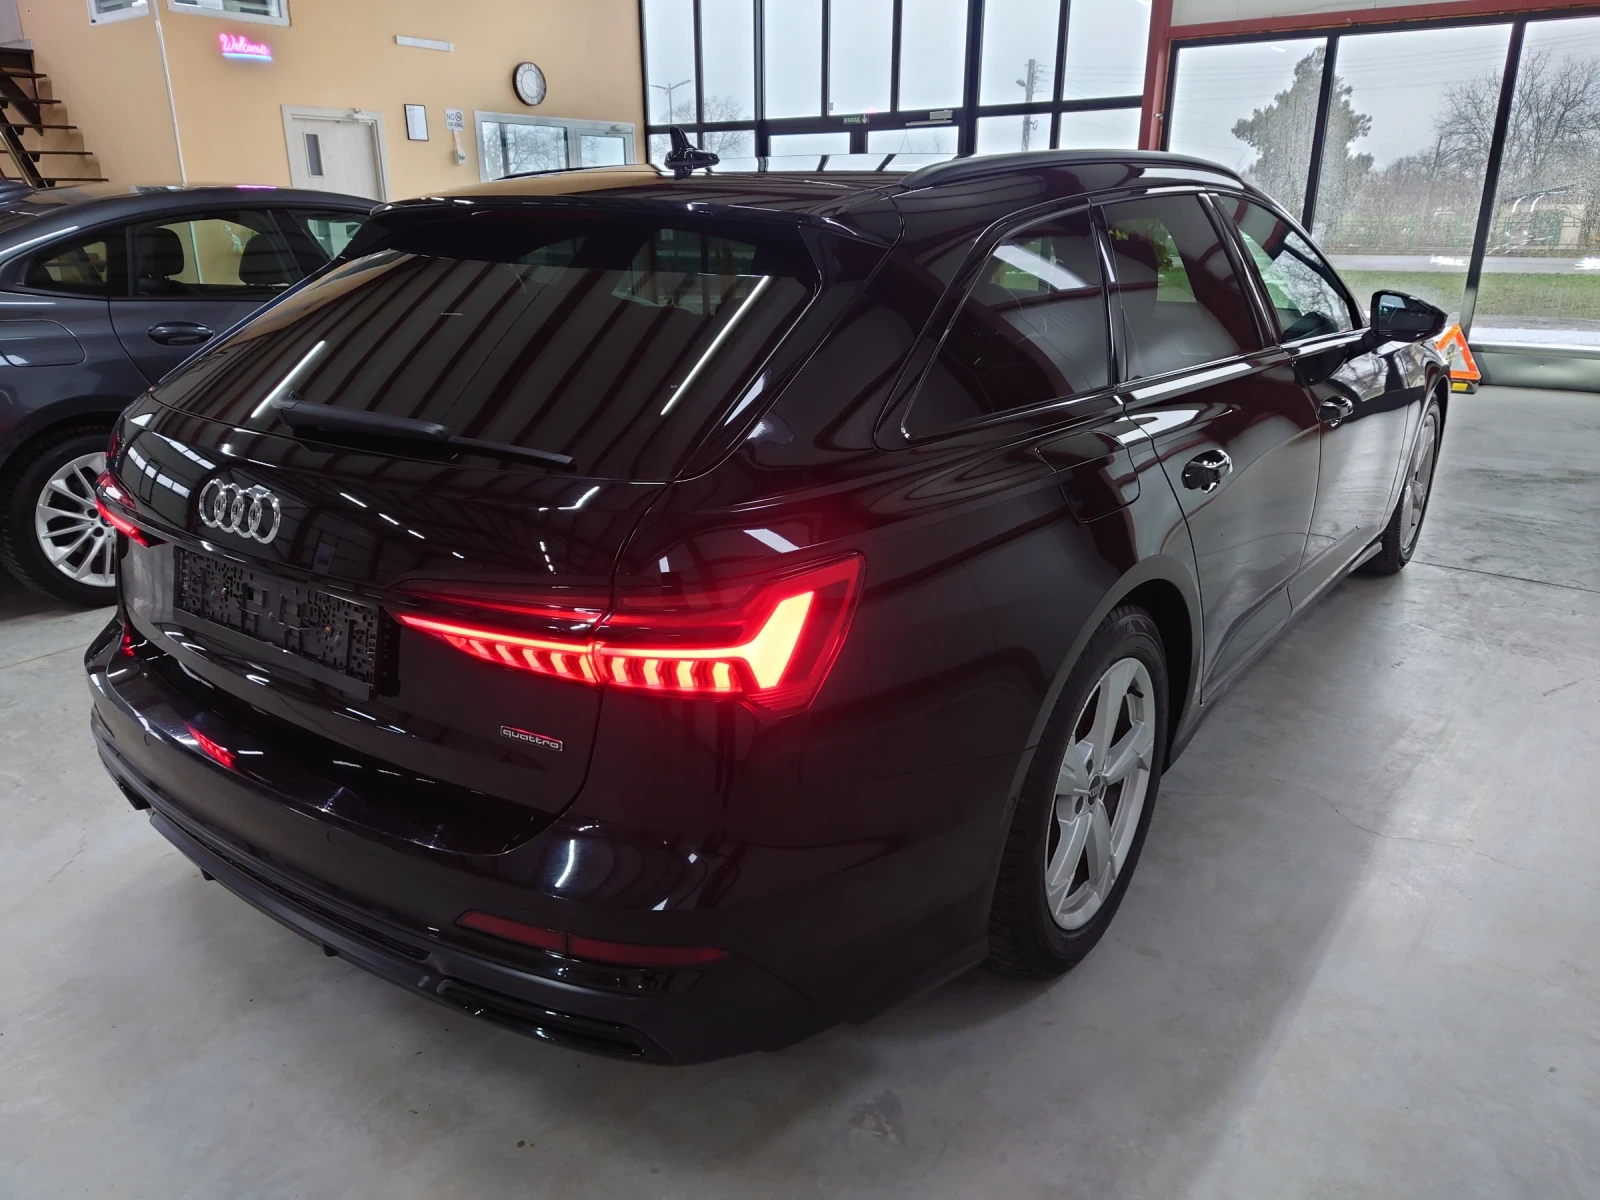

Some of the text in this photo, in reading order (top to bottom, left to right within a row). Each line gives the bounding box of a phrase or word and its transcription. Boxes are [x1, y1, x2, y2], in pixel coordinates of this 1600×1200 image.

[219, 33, 268, 54] Welcome
[446, 113, 455, 121] NO
[502, 729, 559, 749] quattro
